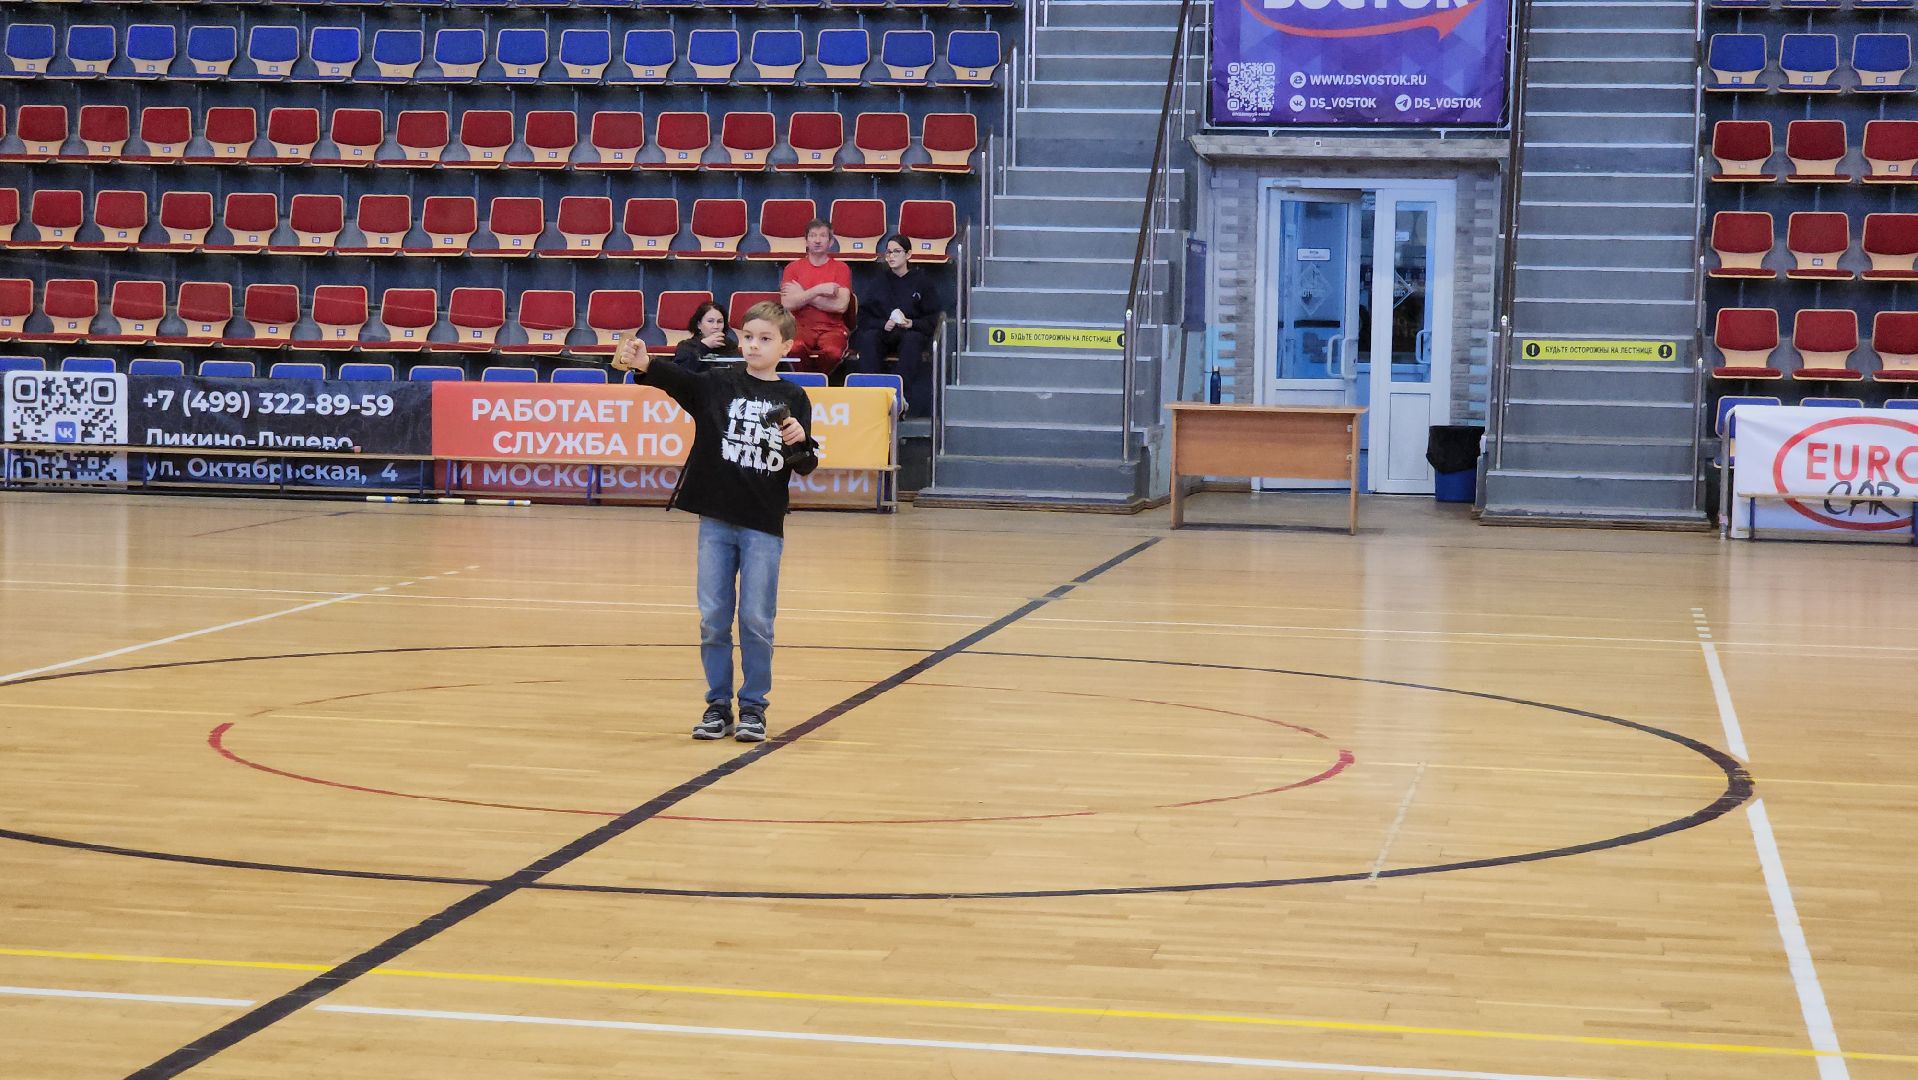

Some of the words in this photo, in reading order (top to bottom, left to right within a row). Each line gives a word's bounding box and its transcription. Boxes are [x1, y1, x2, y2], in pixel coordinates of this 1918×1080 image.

[1309, 74, 1427, 86] WWW.DSVOSTOK.RU
[1309, 97, 1377, 110] DS_VOSTOK
[1414, 97, 1482, 110] DS_VOSTOK
[1010, 332, 1032, 341] БУДЬТЕ
[1034, 332, 1071, 341] ОСТОРОЖНЫ
[1072, 334, 1080, 342] НА
[1081, 335, 1112, 343] ЛЕСТНИЦЕ
[1545, 345, 1568, 353] БУДЬТЕ
[1569, 345, 1609, 353] ОСТОРОЖНЫ
[1620, 346, 1653, 354] ЛЕСТНИЦЕ
[143, 389, 175, 411] +7
[182, 389, 251, 418] (499)
[258, 392, 394, 416] 322-89-59
[472, 398, 634, 423] РАБОТАЕТ
[492, 430, 628, 456] СЛУЖБА
[637, 433, 683, 457] ПО
[725, 419, 783, 451] LIFE
[721, 438, 785, 472] WILD
[145, 460, 181, 482] ул.
[187, 456, 367, 485] Октябрьская,
[381, 462, 399, 482] 4
[452, 462, 473, 485] И
[1823, 480, 1901, 518] CAR
